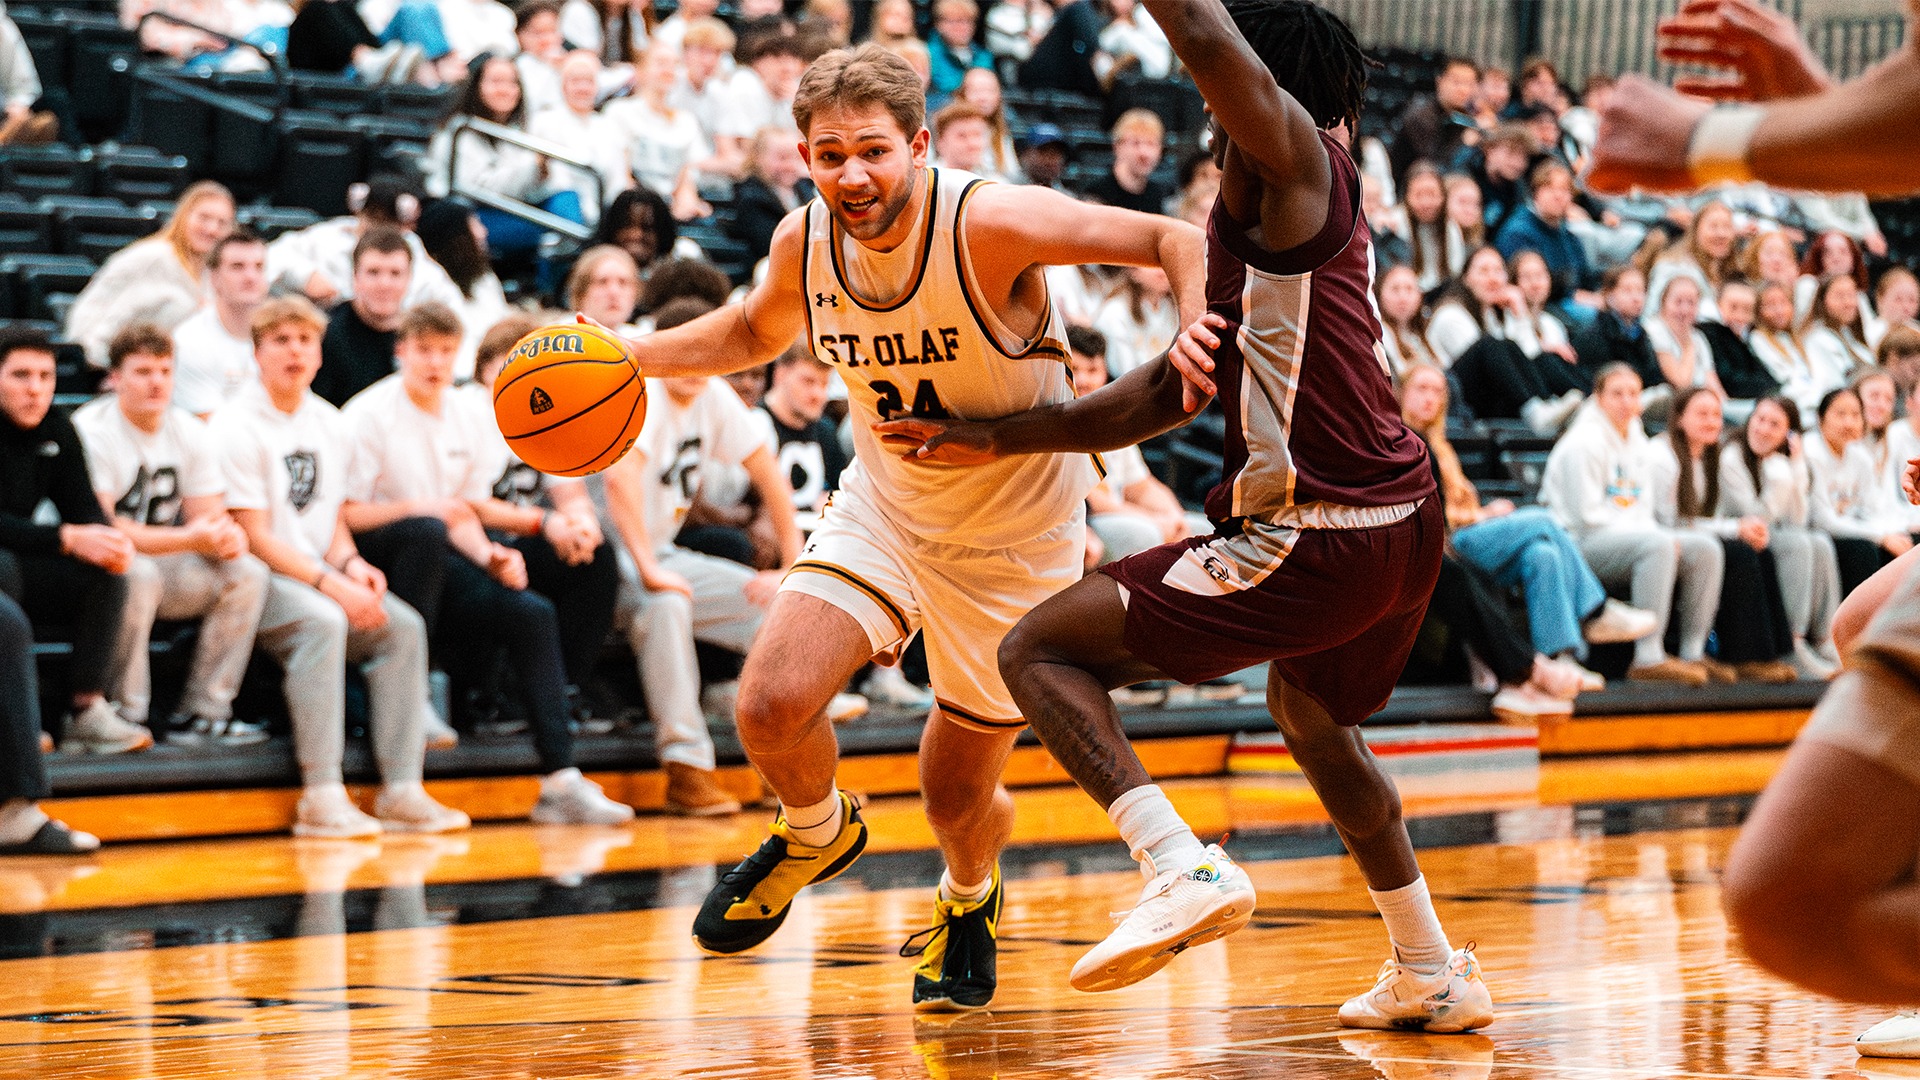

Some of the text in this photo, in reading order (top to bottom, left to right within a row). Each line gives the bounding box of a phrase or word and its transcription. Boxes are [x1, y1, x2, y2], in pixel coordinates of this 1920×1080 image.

[819, 326, 960, 368] ST. OLAF
[867, 378, 950, 422] 24
[114, 464, 186, 527] 42
